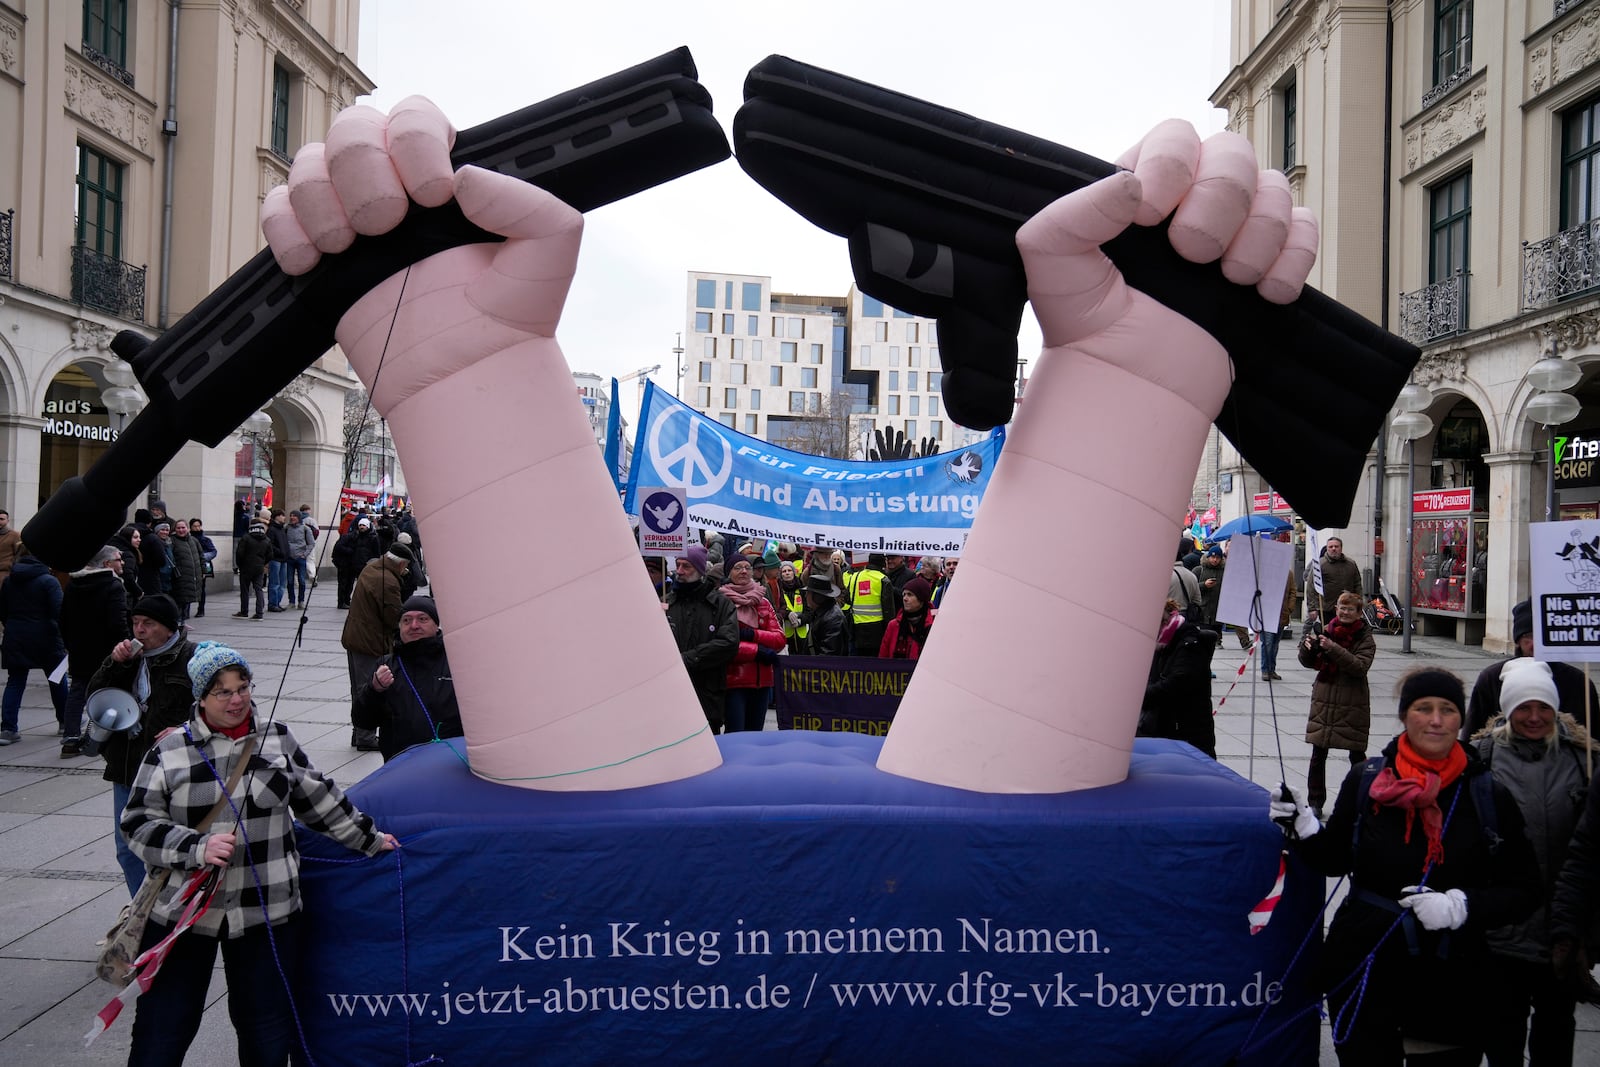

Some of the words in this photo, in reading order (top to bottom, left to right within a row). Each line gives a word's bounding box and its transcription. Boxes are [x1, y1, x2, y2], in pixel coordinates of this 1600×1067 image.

[42, 417, 119, 442] McDonald's
[736, 445, 797, 469] Für
[1572, 436, 1600, 460] fre
[733, 476, 792, 507] und
[803, 485, 979, 518] Abrüstung
[1428, 494, 1444, 510] 70%
[1443, 495, 1470, 506] REDUZIERT
[689, 513, 960, 551] www.Augsburger-FriedensInitiative.de
[1546, 597, 1572, 611] Nie
[1546, 612, 1600, 627] Faschis
[1549, 627, 1578, 642] und
[783, 668, 909, 697] INTERNATIONALE
[792, 713, 823, 731] FÜR
[500, 924, 595, 963] Kein
[609, 920, 721, 968] Krieg
[736, 919, 771, 956] in
[785, 917, 944, 955] meinem
[958, 916, 1111, 954] Namen.
[328, 974, 791, 1025] www.jetzt-abruesten.de
[803, 970, 819, 1009] /
[829, 970, 1283, 1017] www.dfg-vk-bayern.de
